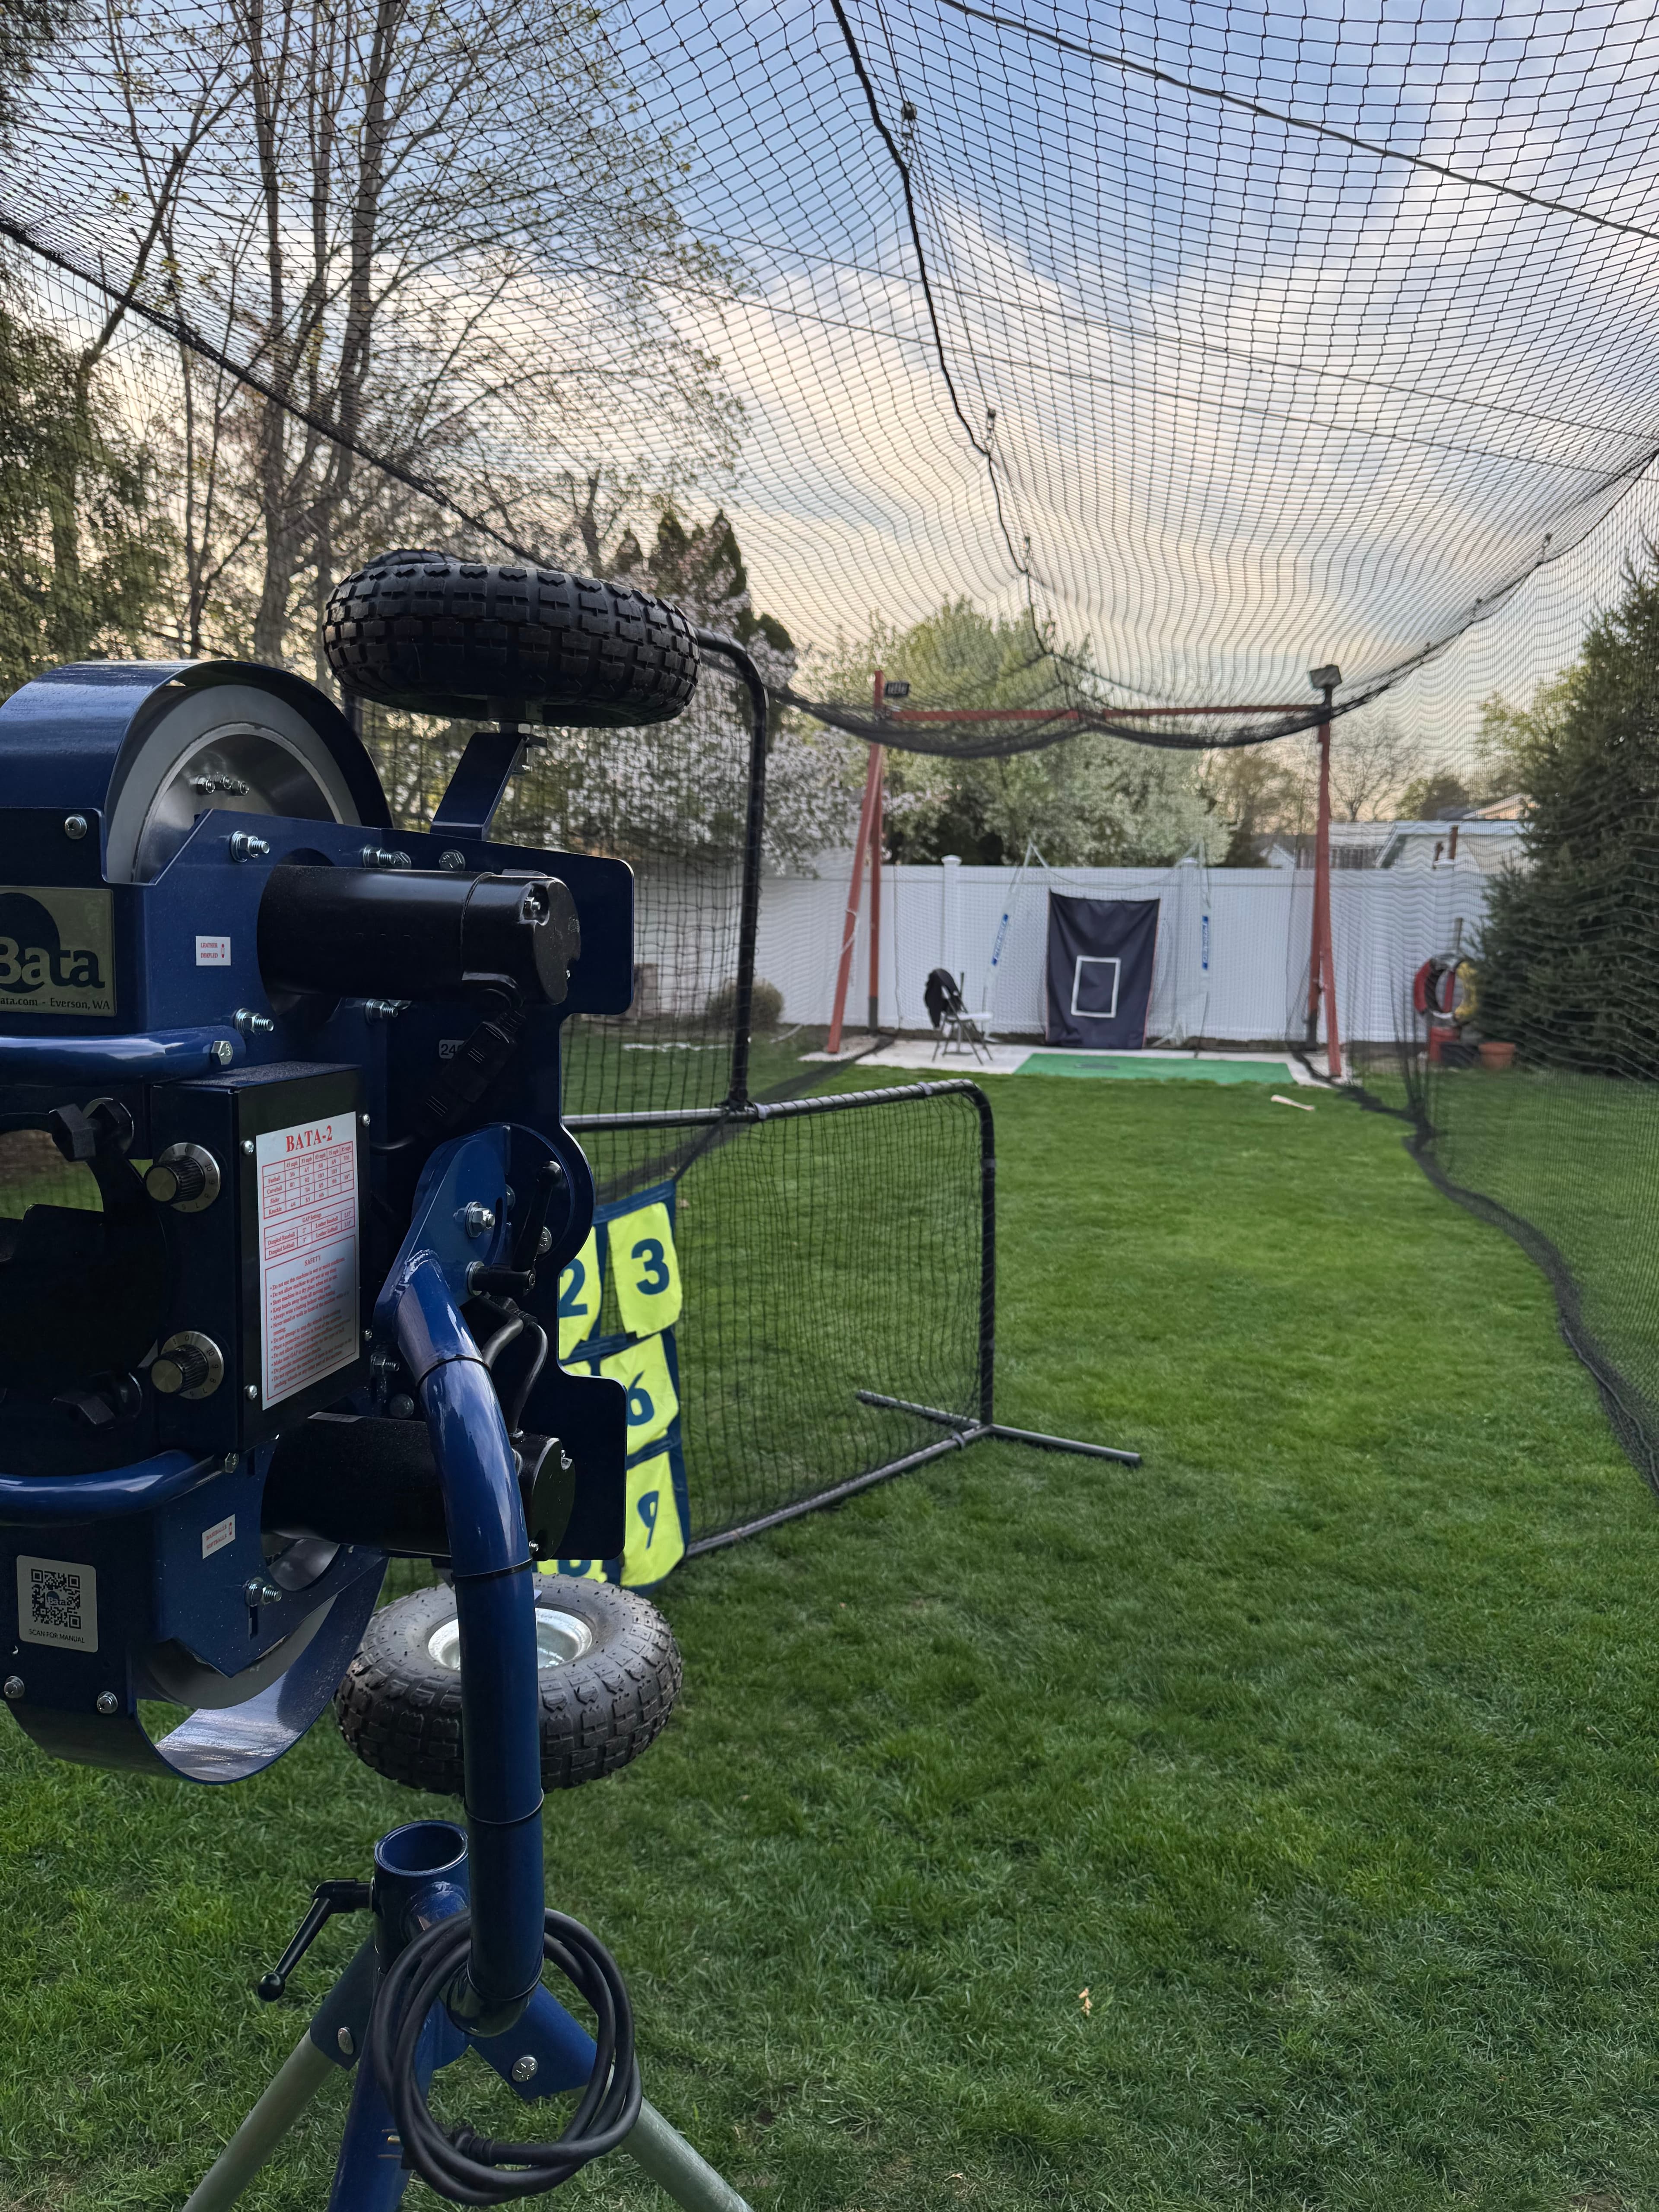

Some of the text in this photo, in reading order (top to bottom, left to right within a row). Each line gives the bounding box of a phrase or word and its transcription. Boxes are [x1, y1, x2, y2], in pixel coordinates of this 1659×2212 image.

[0, 937, 105, 988] Bata
[50, 998, 90, 1010] Everson,
[92, 1000, 110, 1010] WA
[286, 1125, 333, 1152] BATA-2
[305, 1255, 320, 1266] SAFETY
[631, 1238, 670, 1295] 3
[559, 1258, 588, 1317] 2
[627, 1370, 655, 1426] 6
[637, 1491, 659, 1550] 9
[29, 1628, 45, 1638] SCAN
[60, 1634, 85, 1643] MANUAL
